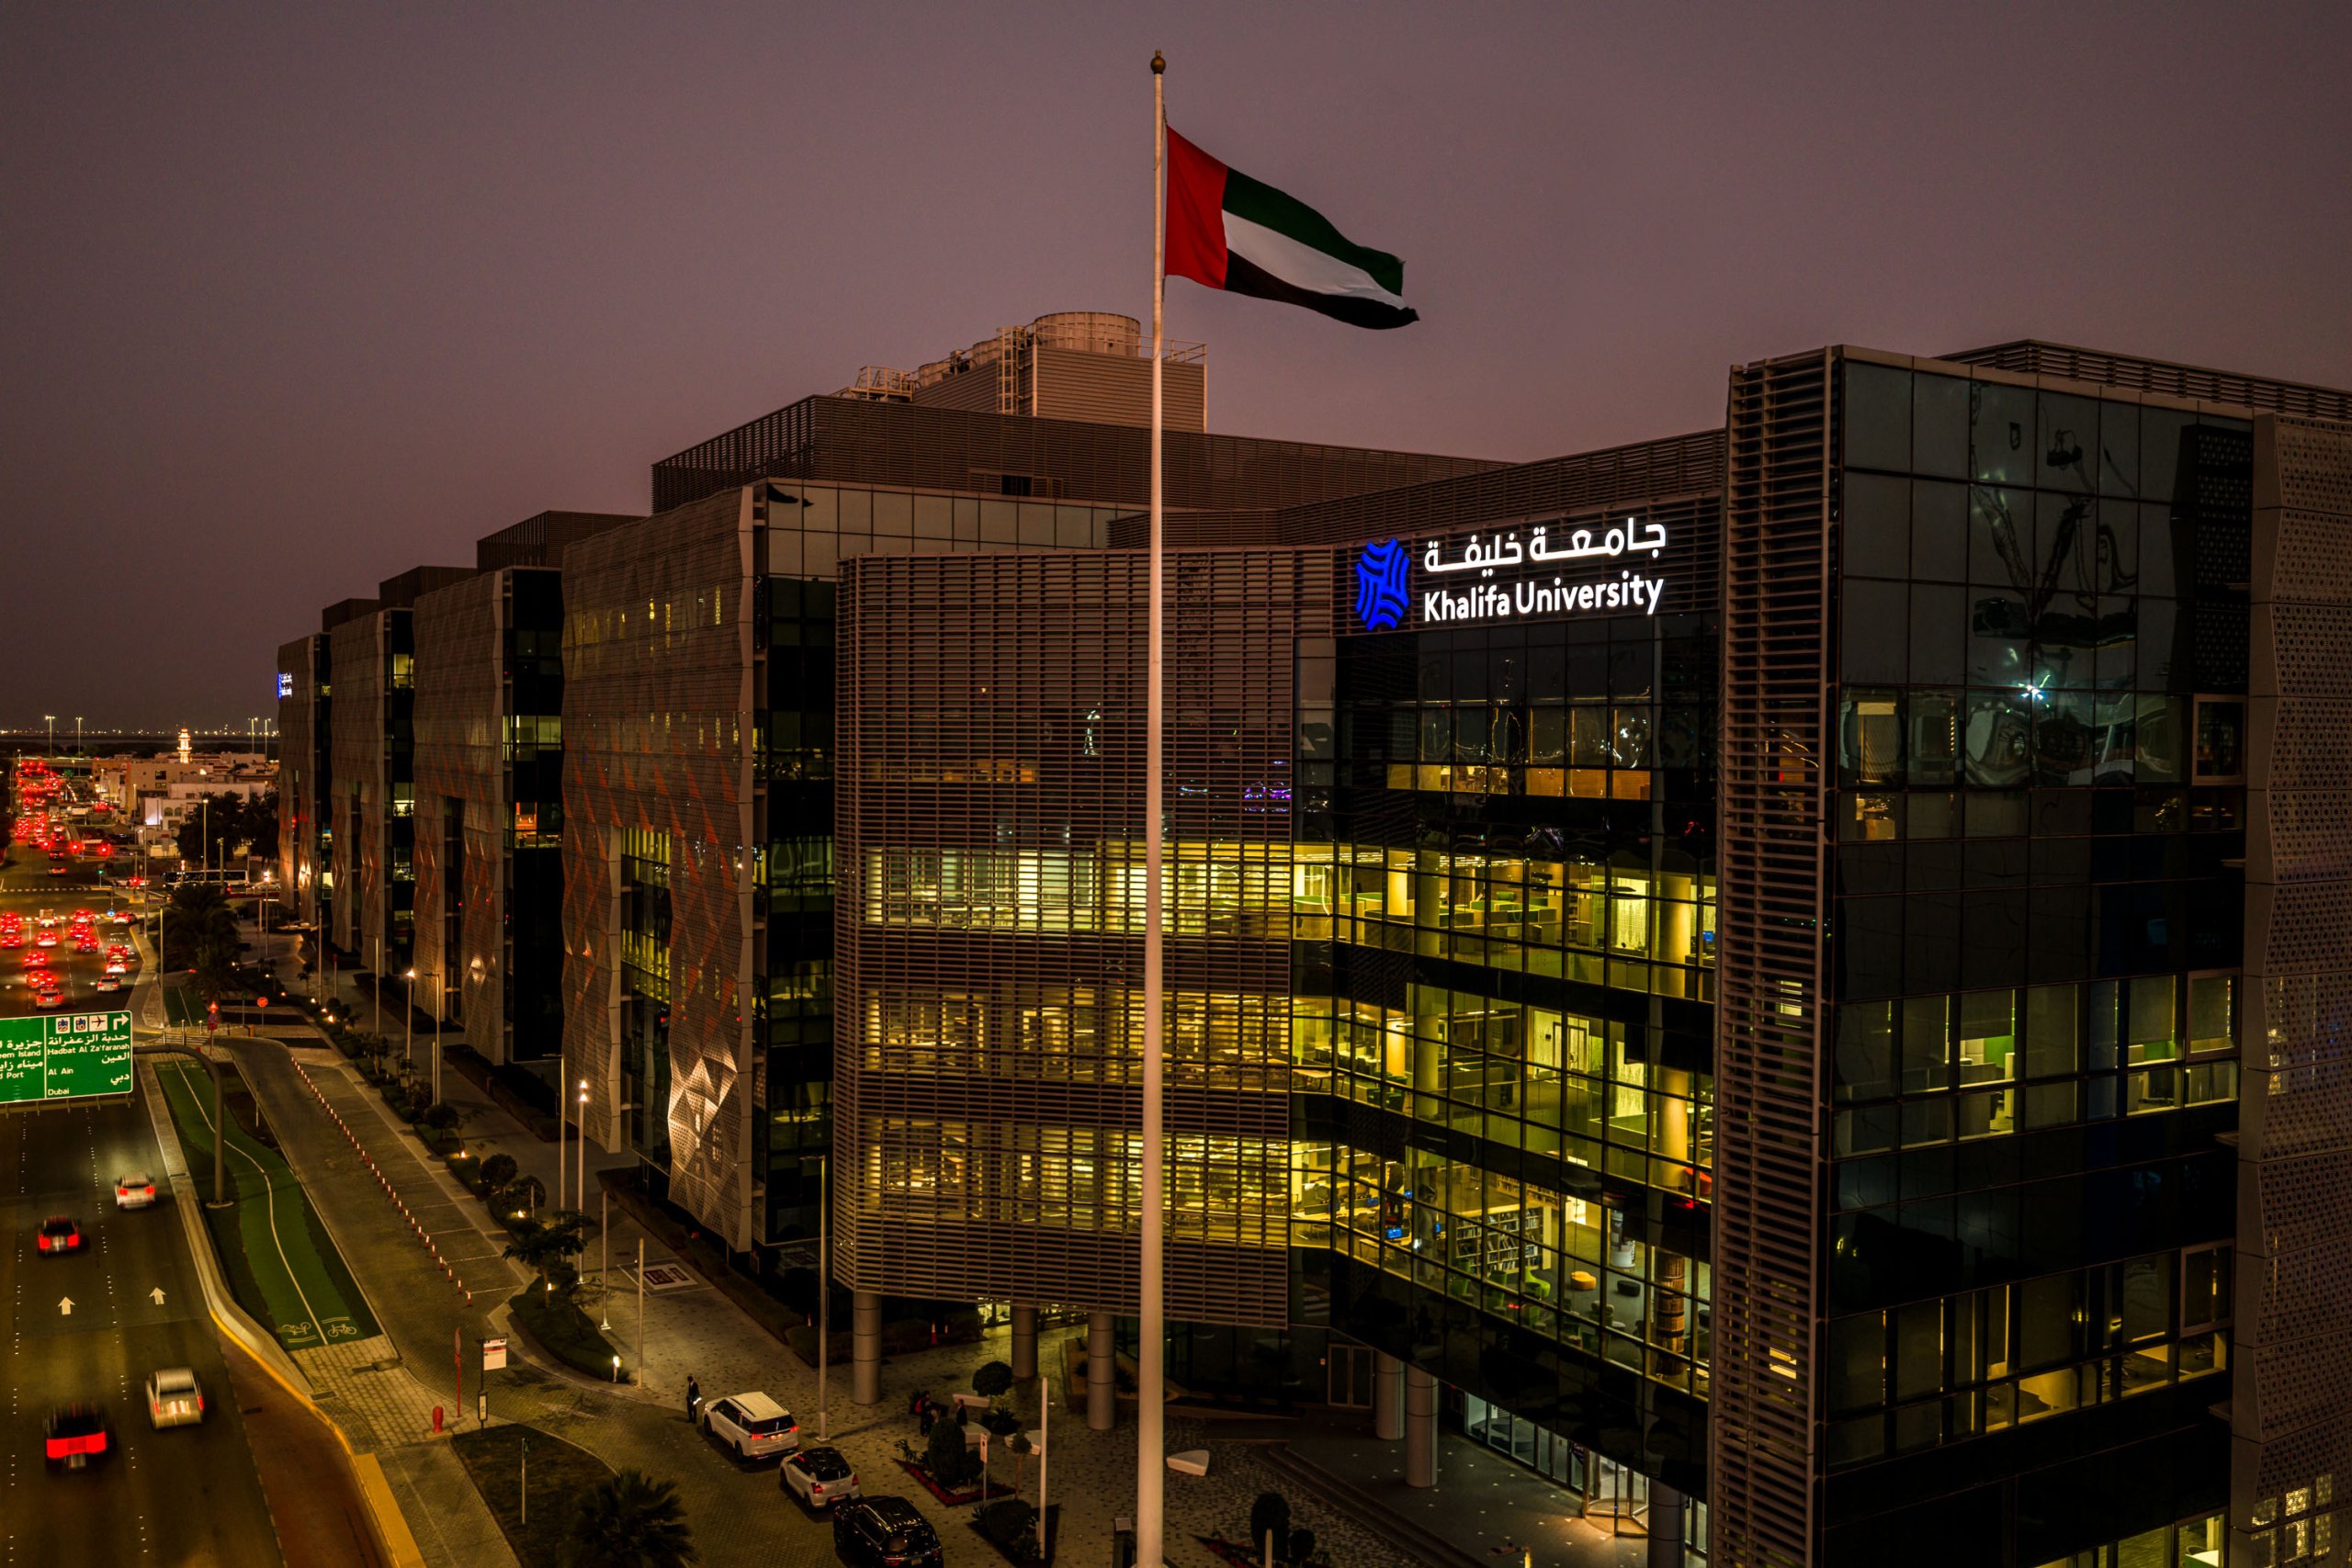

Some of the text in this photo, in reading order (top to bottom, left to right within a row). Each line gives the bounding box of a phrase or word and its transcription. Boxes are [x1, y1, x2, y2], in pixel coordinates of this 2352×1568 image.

[1424, 516, 1667, 577] جامعة خليفة
[1424, 570, 1664, 622] Khalifa University
[6, 1040, 43, 1050] جزيرة
[47, 1047, 75, 1055] Hadbat
[90, 1043, 130, 1052] Za'faranah
[18, 1049, 41, 1057] Island
[101, 1052, 130, 1064] العين
[17, 1059, 43, 1069] ميناء
[110, 1073, 130, 1085] دبي
